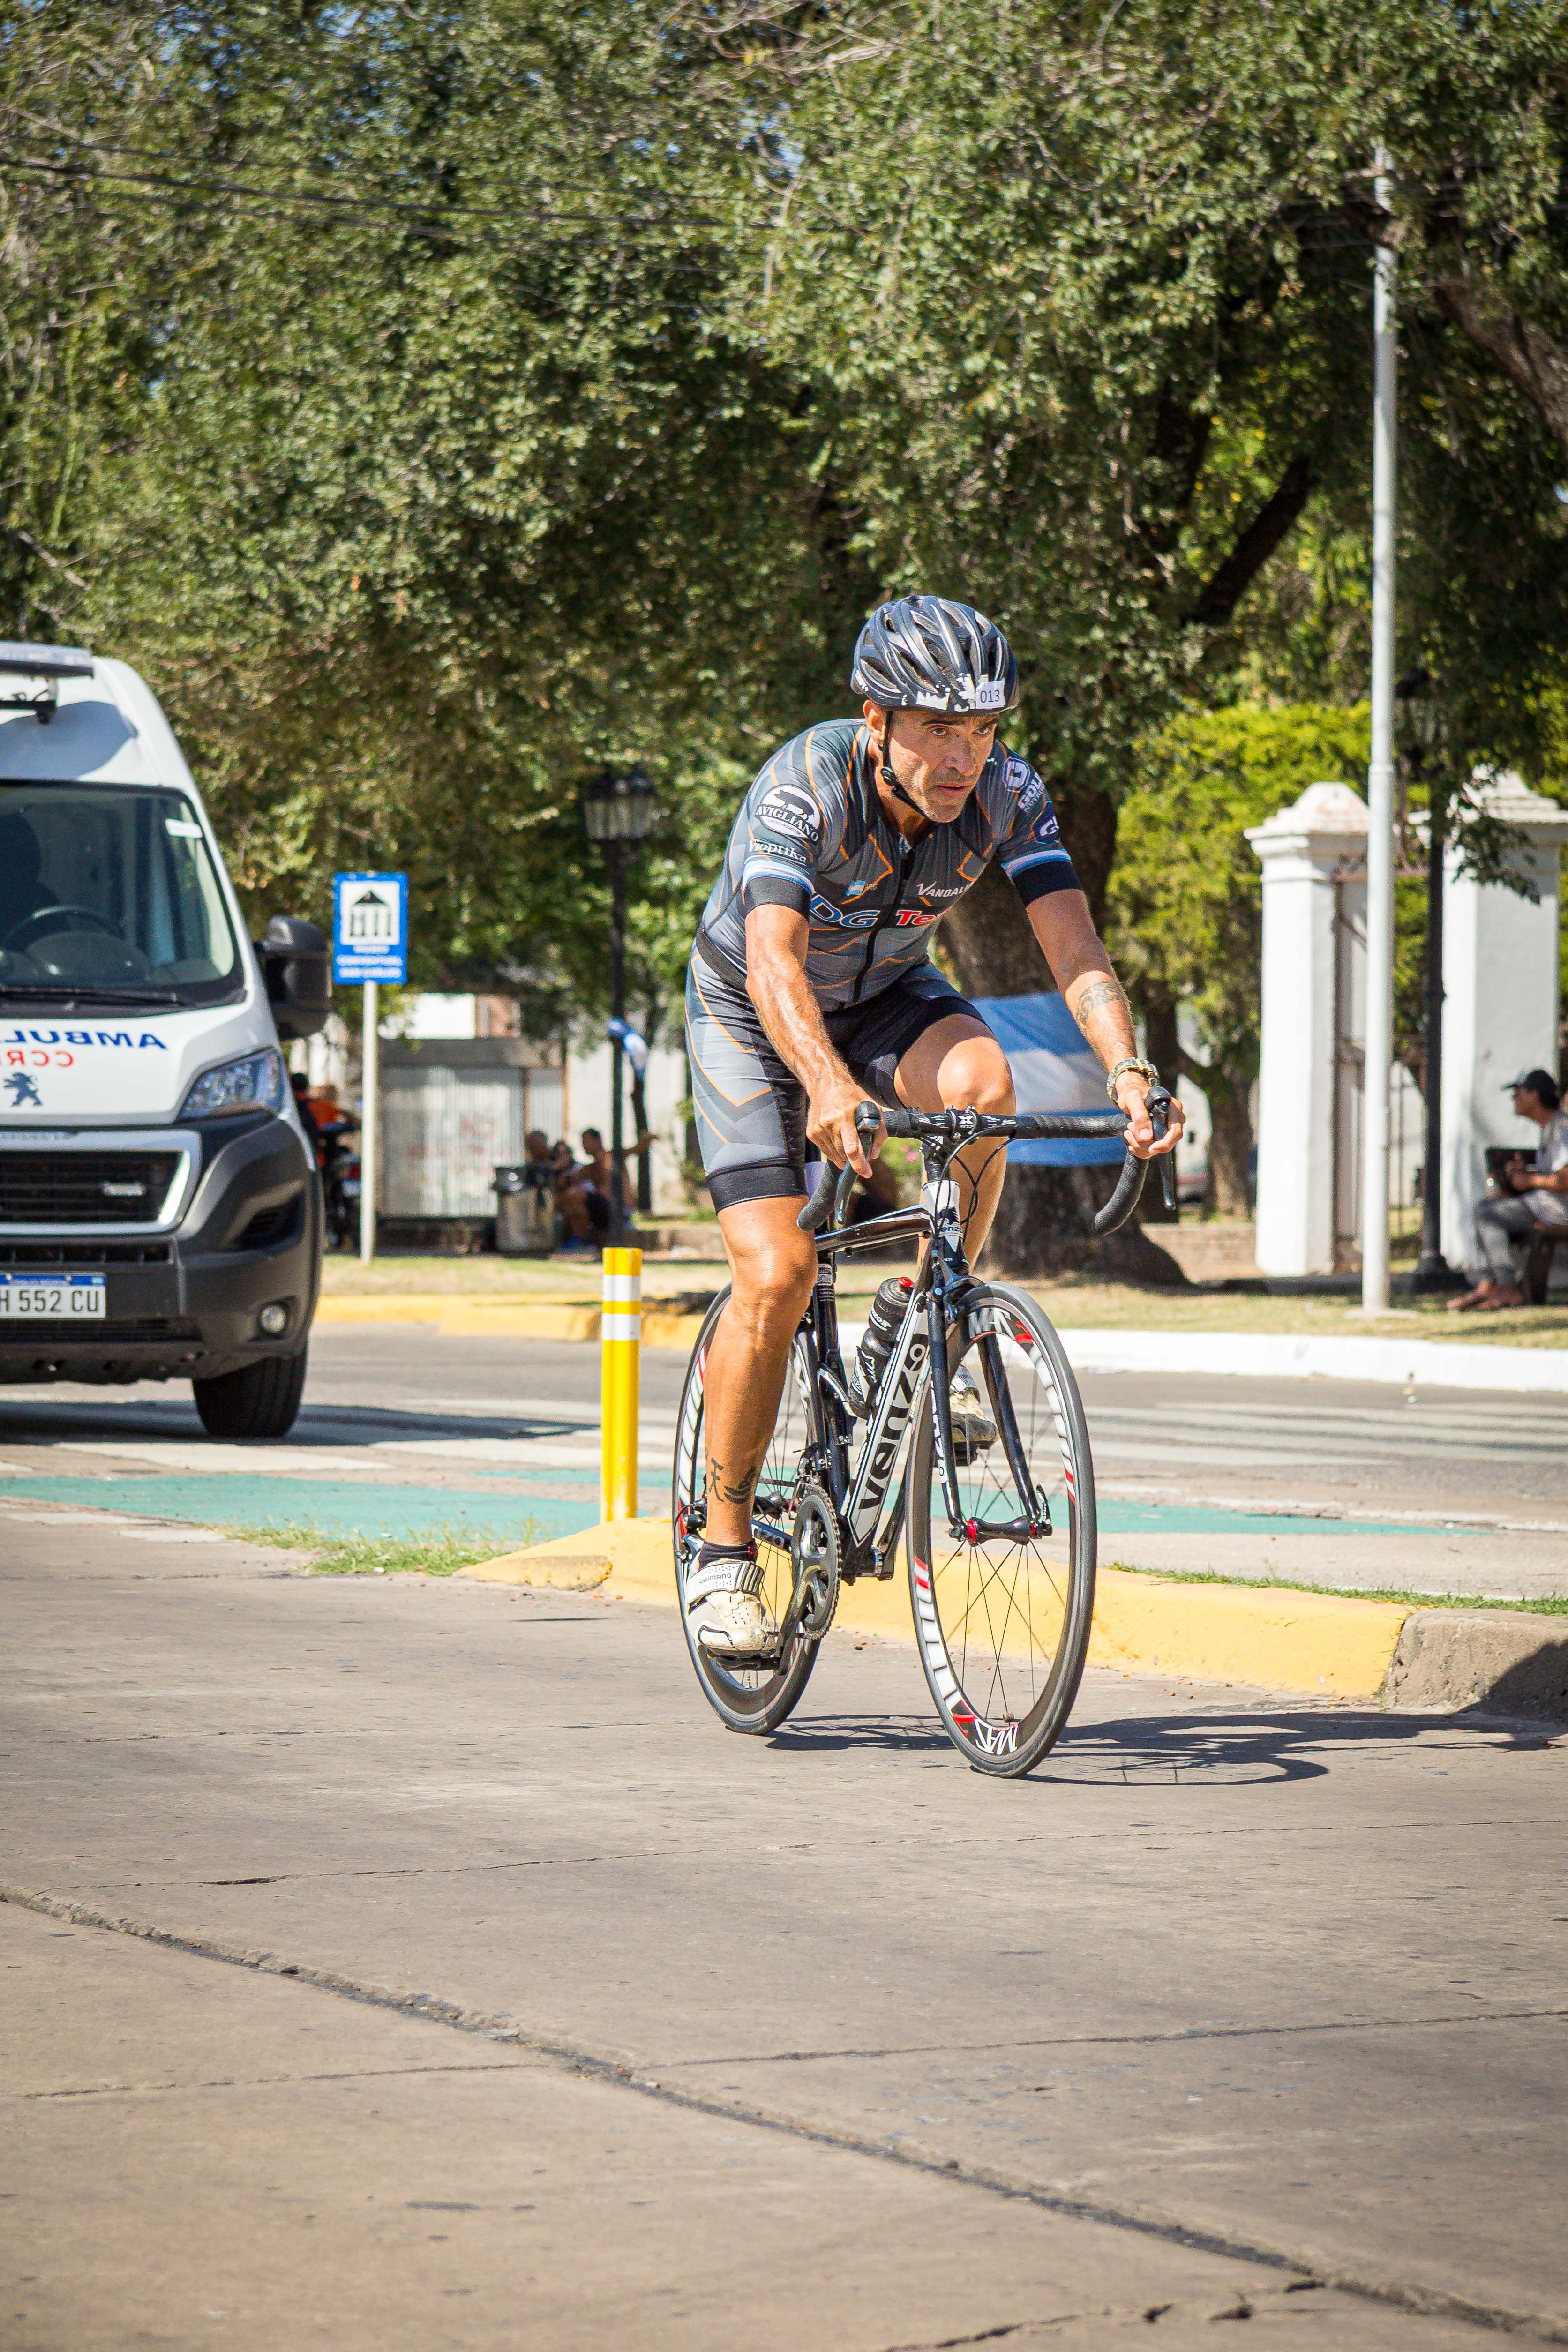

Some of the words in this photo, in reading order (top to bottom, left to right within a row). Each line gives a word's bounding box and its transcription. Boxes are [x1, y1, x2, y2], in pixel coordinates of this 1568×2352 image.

[980, 689, 1000, 703] 013
[756, 806, 818, 841] AVIGLIANO
[810, 894, 881, 928] DG
[895, 910, 940, 926] Te
[19, 1290, 61, 1312] 552
[72, 1291, 99, 1312] CU
